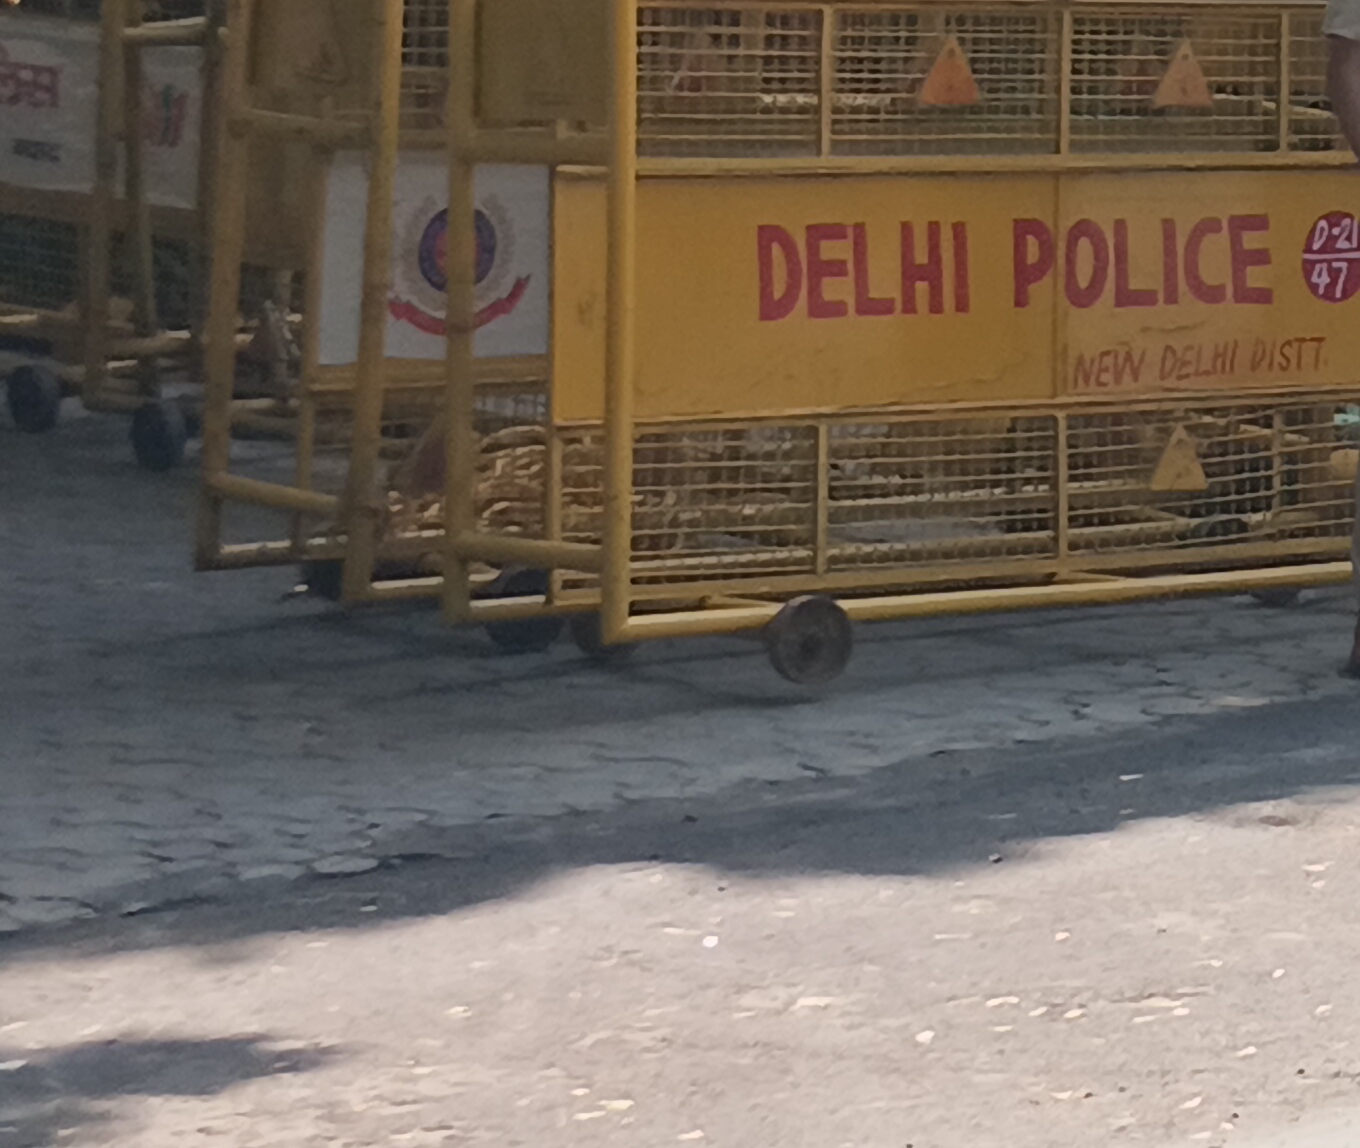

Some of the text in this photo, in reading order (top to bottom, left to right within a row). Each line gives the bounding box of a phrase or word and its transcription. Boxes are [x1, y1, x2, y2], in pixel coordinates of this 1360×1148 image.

[757, 213, 1274, 320] DELHI POLICE
[1310, 261, 1348, 299] 47
[1073, 348, 1146, 390] NEW
[1158, 339, 1240, 382] DELHI
